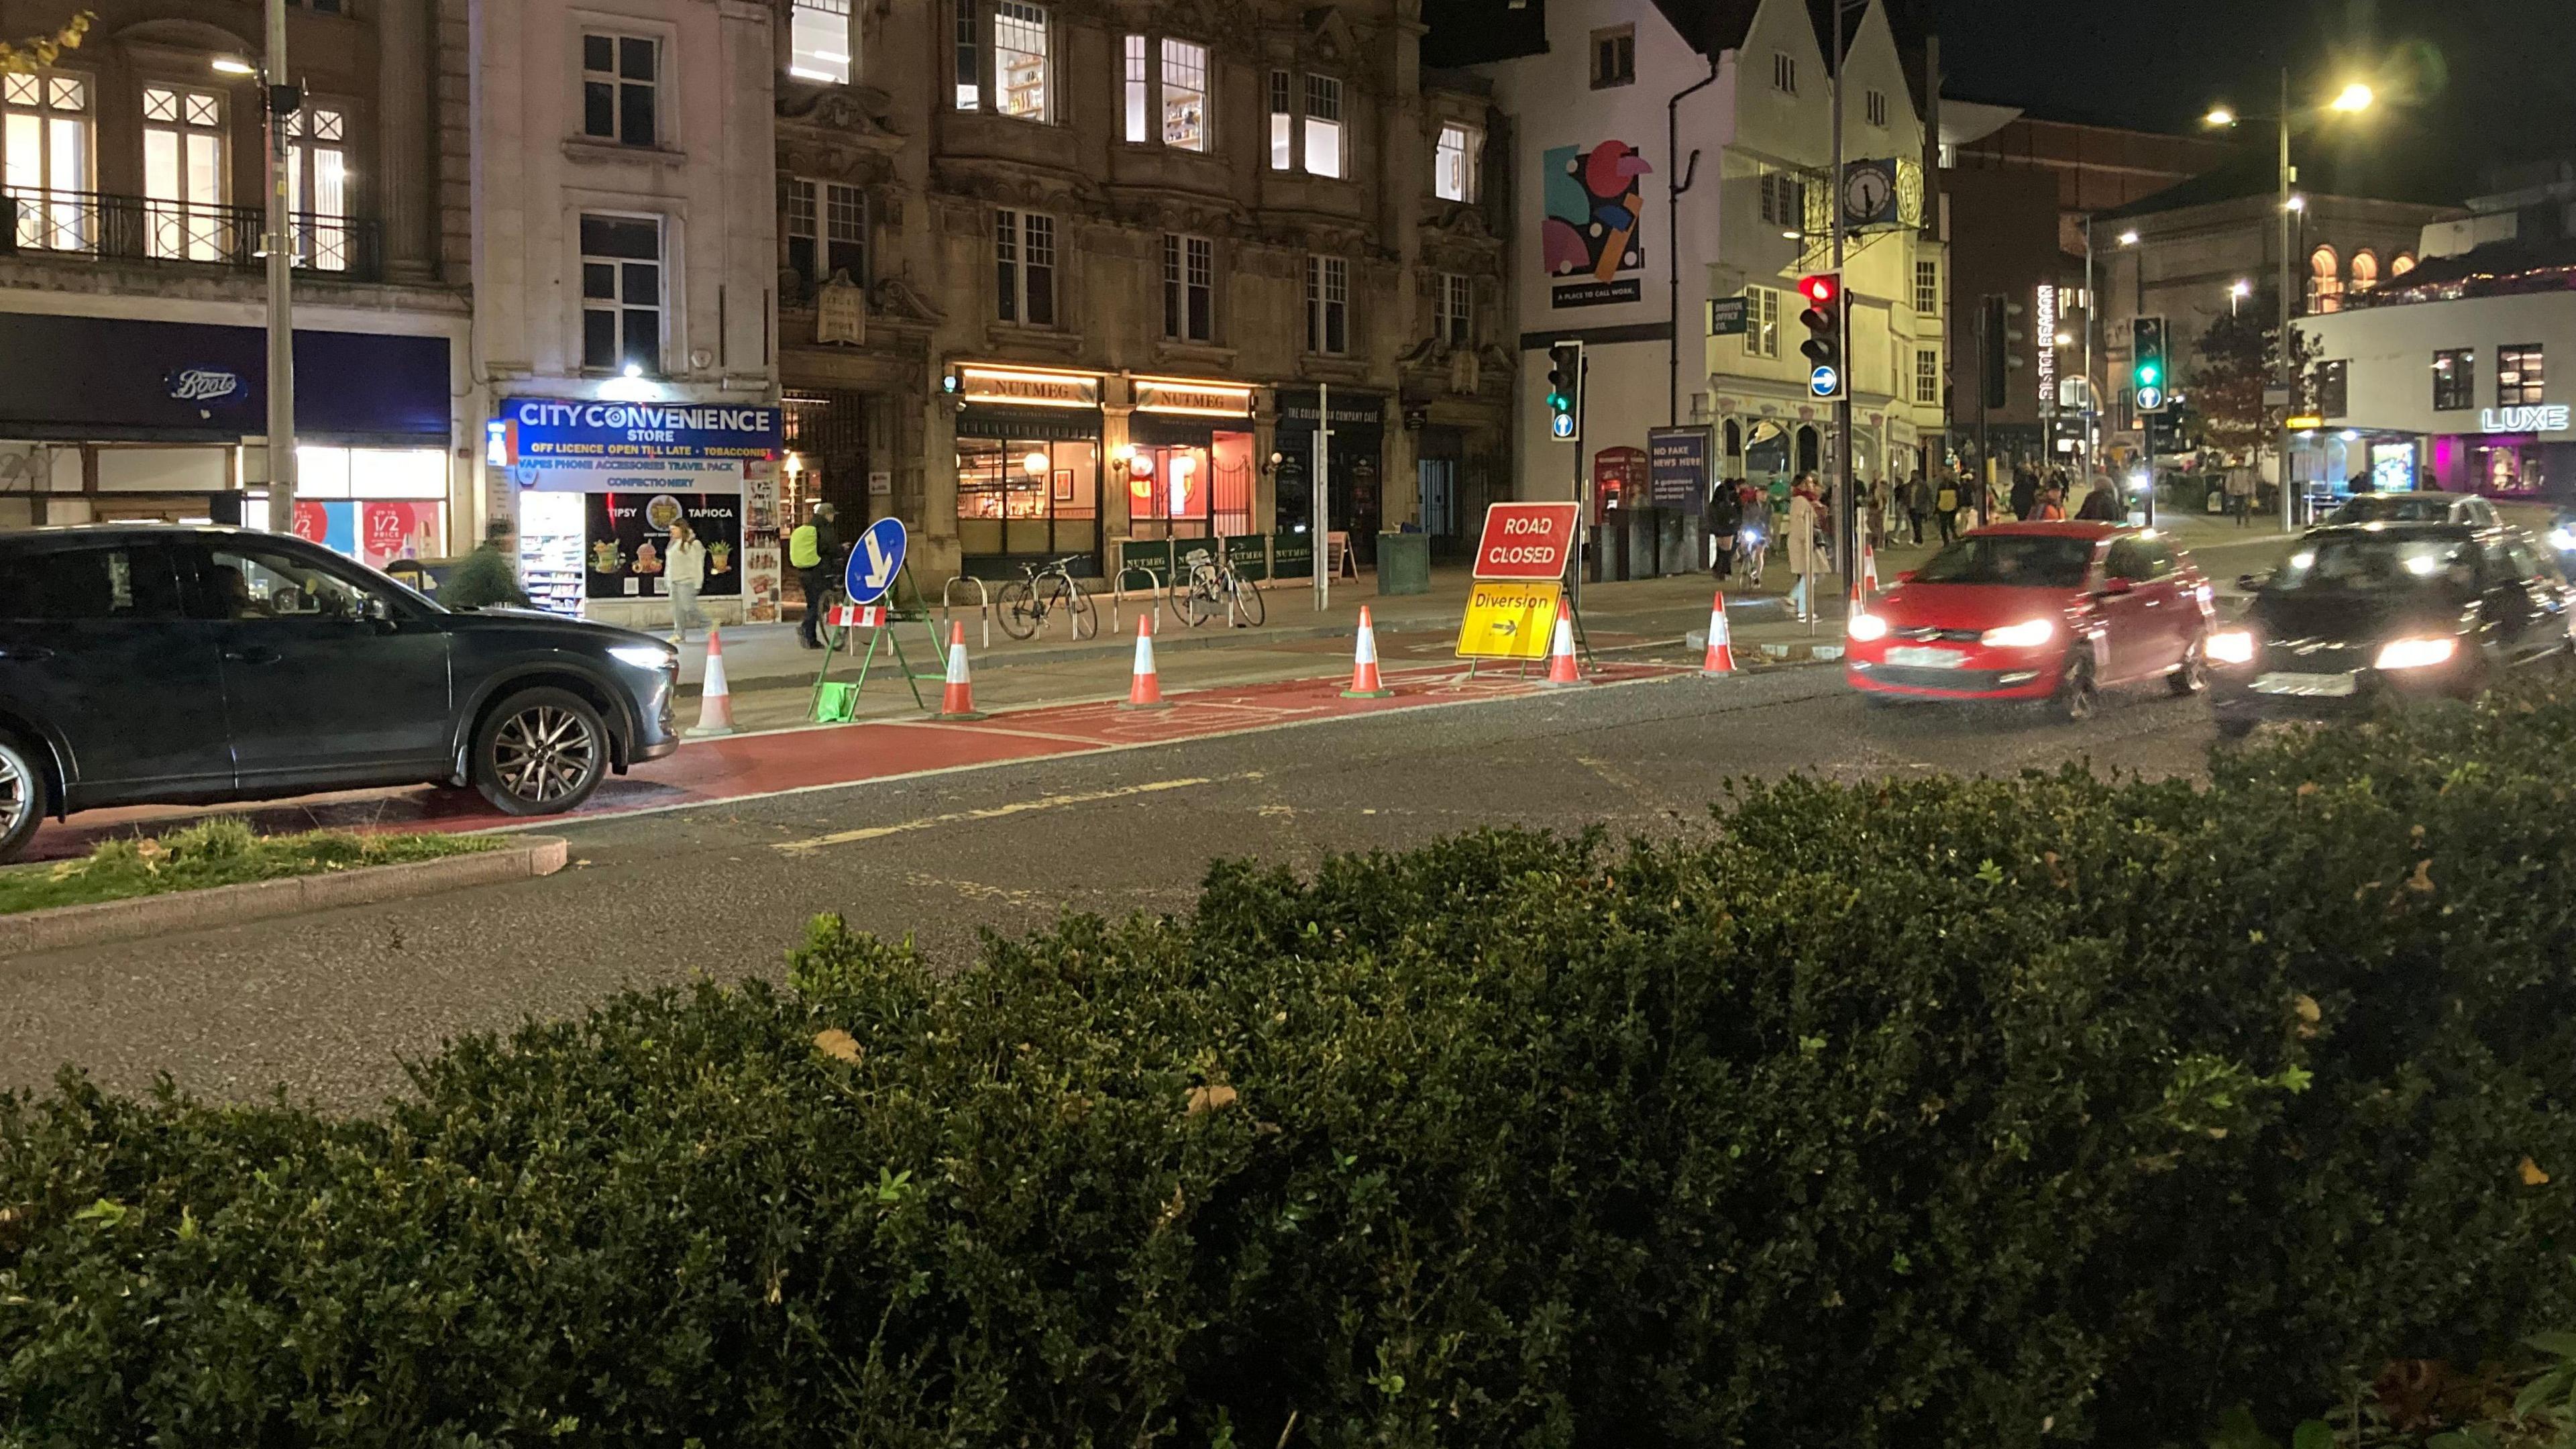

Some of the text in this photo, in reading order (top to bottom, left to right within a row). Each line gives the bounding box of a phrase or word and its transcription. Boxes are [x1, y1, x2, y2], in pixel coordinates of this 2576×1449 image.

[1564, 292, 1583, 300] PLACE
[1595, 289, 1611, 297] CALL
[171, 370, 237, 400] Boots
[994, 380, 1069, 398] NUTMEG
[1161, 391, 1224, 409] NUTMEG
[519, 403, 770, 432] CITY CONVENIENCE
[1288, 407, 1299, 419] THE
[1336, 410, 1362, 422] COMPANY
[2481, 405, 2569, 433] LUXE
[627, 429, 675, 443] STORE
[531, 443, 771, 458] OFF LICENCE OPEN TILL LATE TOBACCONIST
[1654, 447, 1688, 455] NO FAKE
[519, 459, 734, 472] VAPES PHONE ACCESSORIES TRAVEL PACK
[1654, 459, 1676, 467] NEWS
[608, 508, 733, 518] TIPSY TAPIOCA
[373, 516, 399, 531] 1/2
[1504, 518, 1552, 535] ROAD
[1234, 550, 1264, 561] UTMEG
[1275, 548, 1310, 559] NUTMEG
[1489, 547, 1555, 564] CLOSED
[1126, 557, 1165, 568] NUTMEG
[1476, 593, 1548, 608] Diversion
